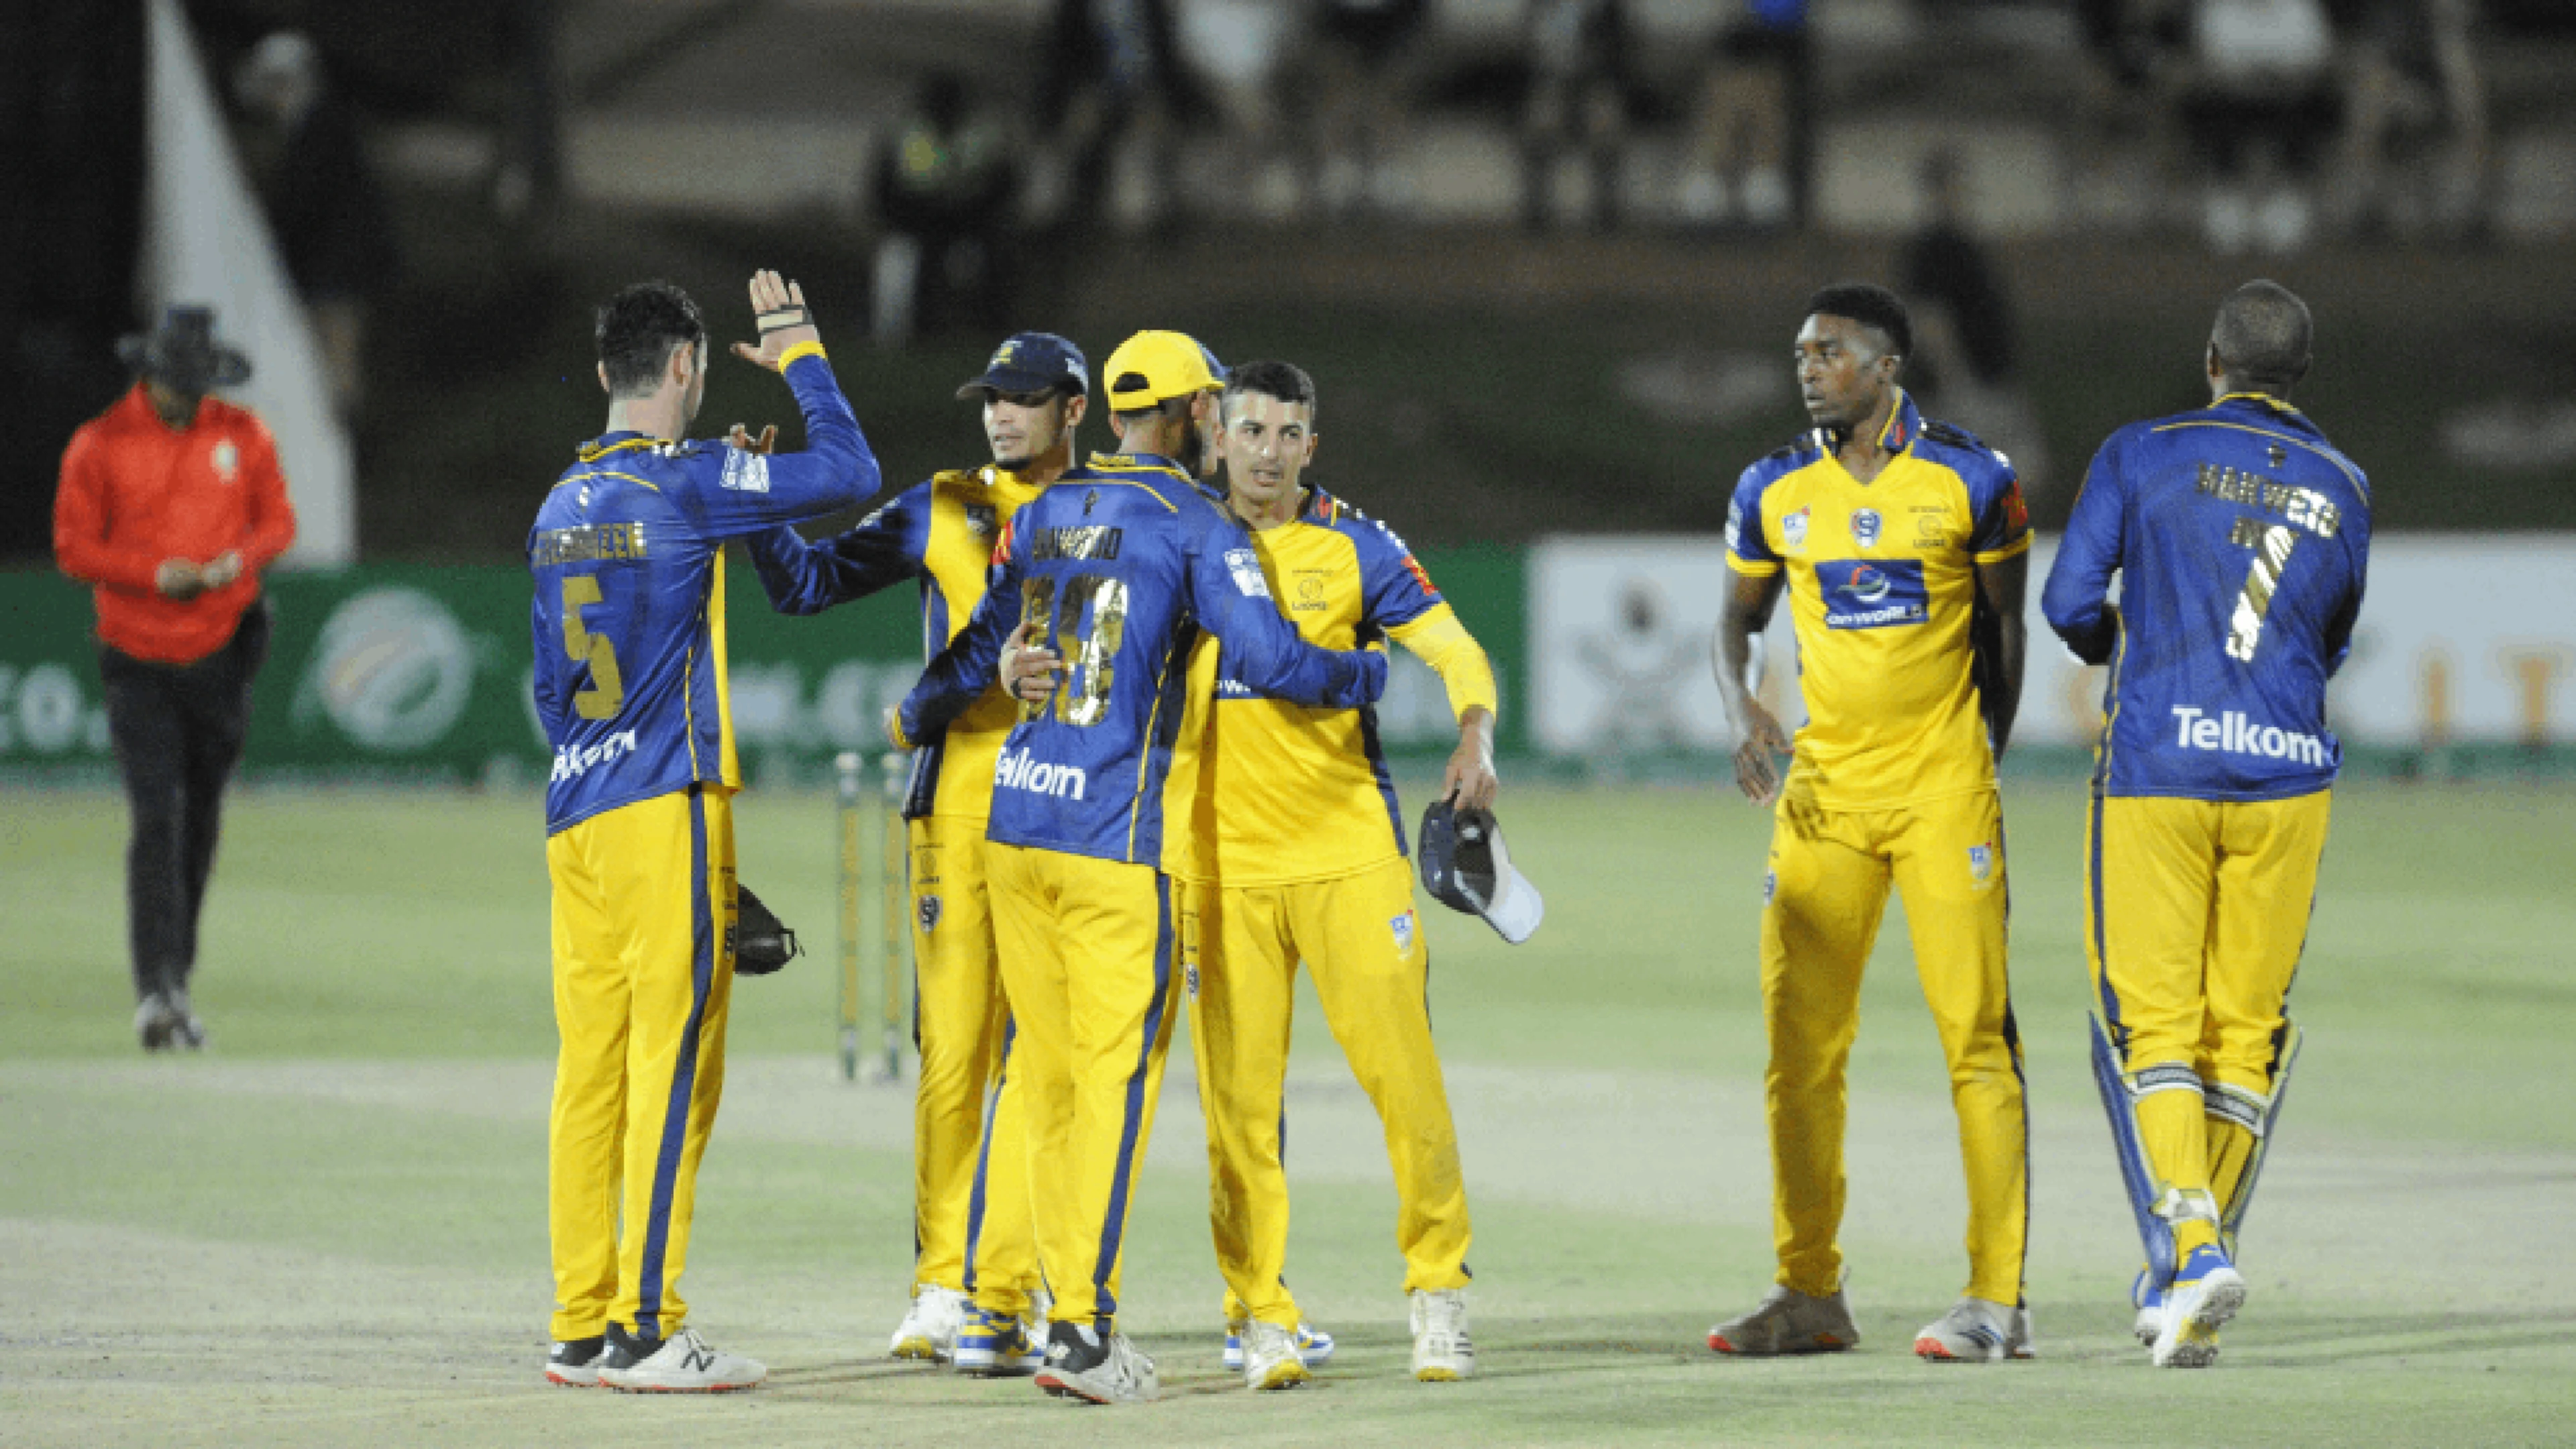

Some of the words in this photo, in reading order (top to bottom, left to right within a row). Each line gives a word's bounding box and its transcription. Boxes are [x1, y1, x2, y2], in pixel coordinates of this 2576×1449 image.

[561, 574, 625, 720] 5
[2226, 517, 2300, 662] 7
[2171, 704, 2323, 768] Telkom
